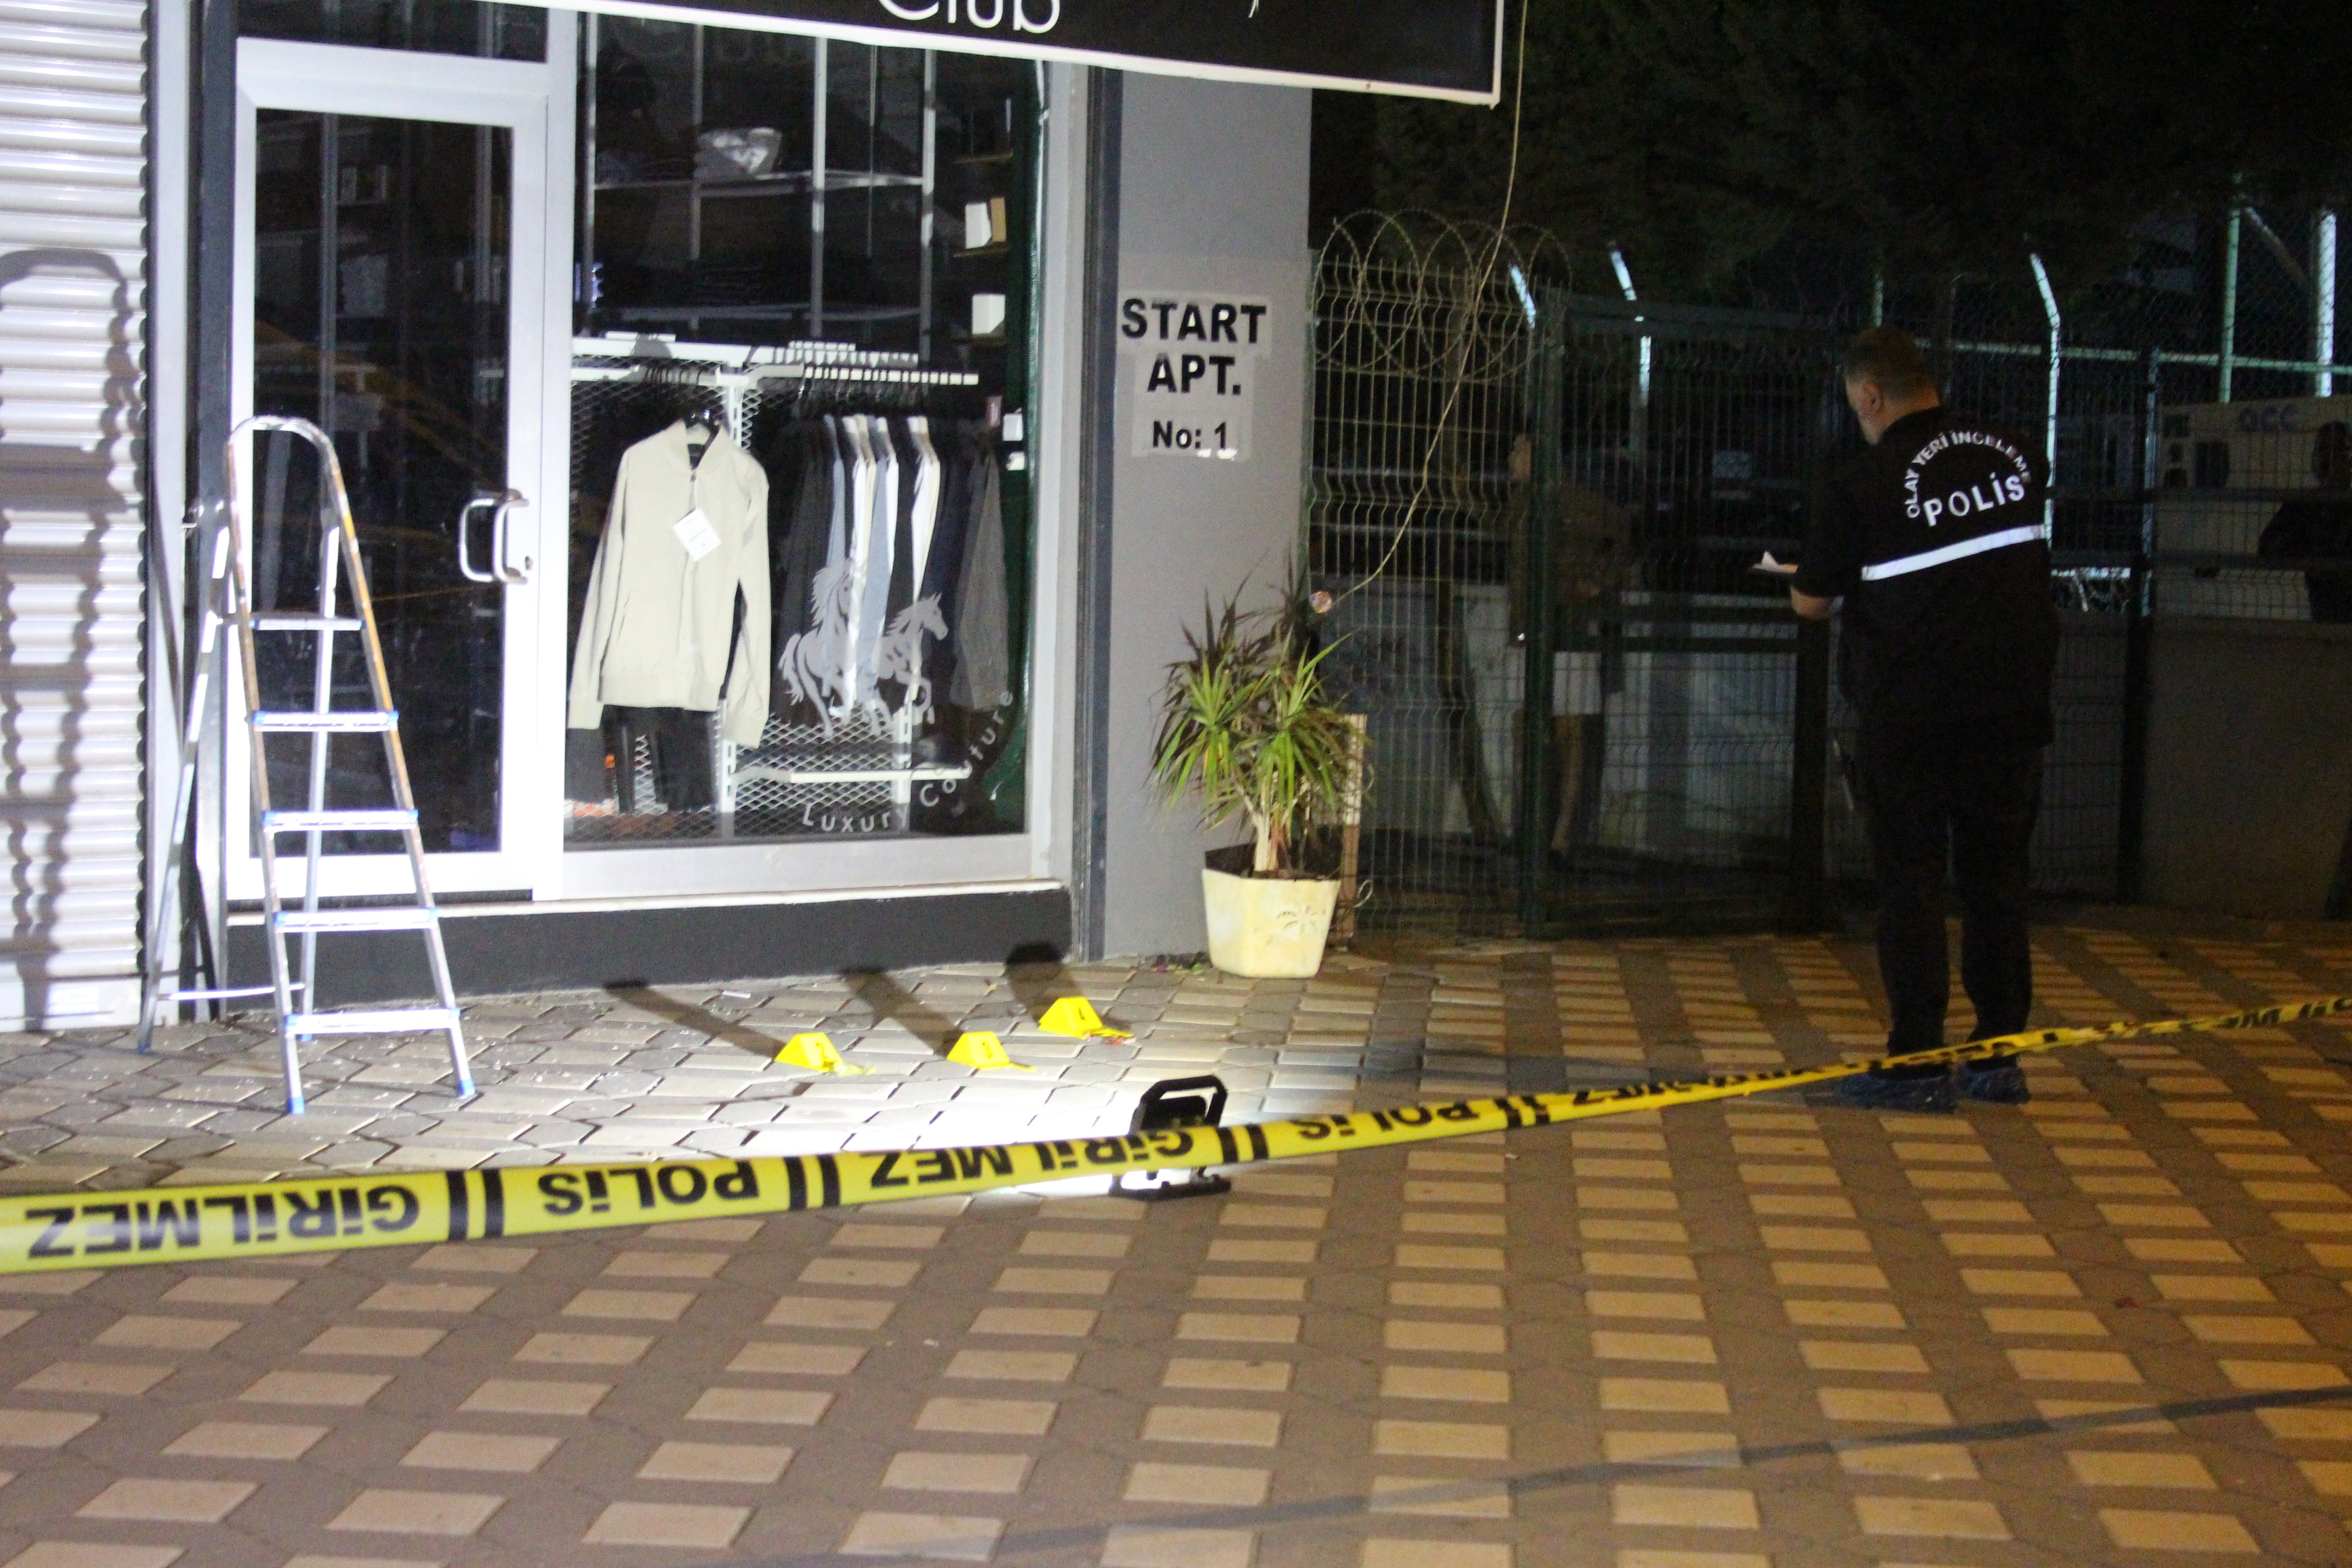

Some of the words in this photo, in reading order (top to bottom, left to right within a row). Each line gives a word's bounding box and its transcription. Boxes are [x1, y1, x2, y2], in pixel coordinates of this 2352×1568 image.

[1122, 298, 1267, 344] START
[1147, 353, 1241, 395] APT.
[1905, 468, 1920, 518] OLAY
[1923, 471, 2025, 527] POLİS
